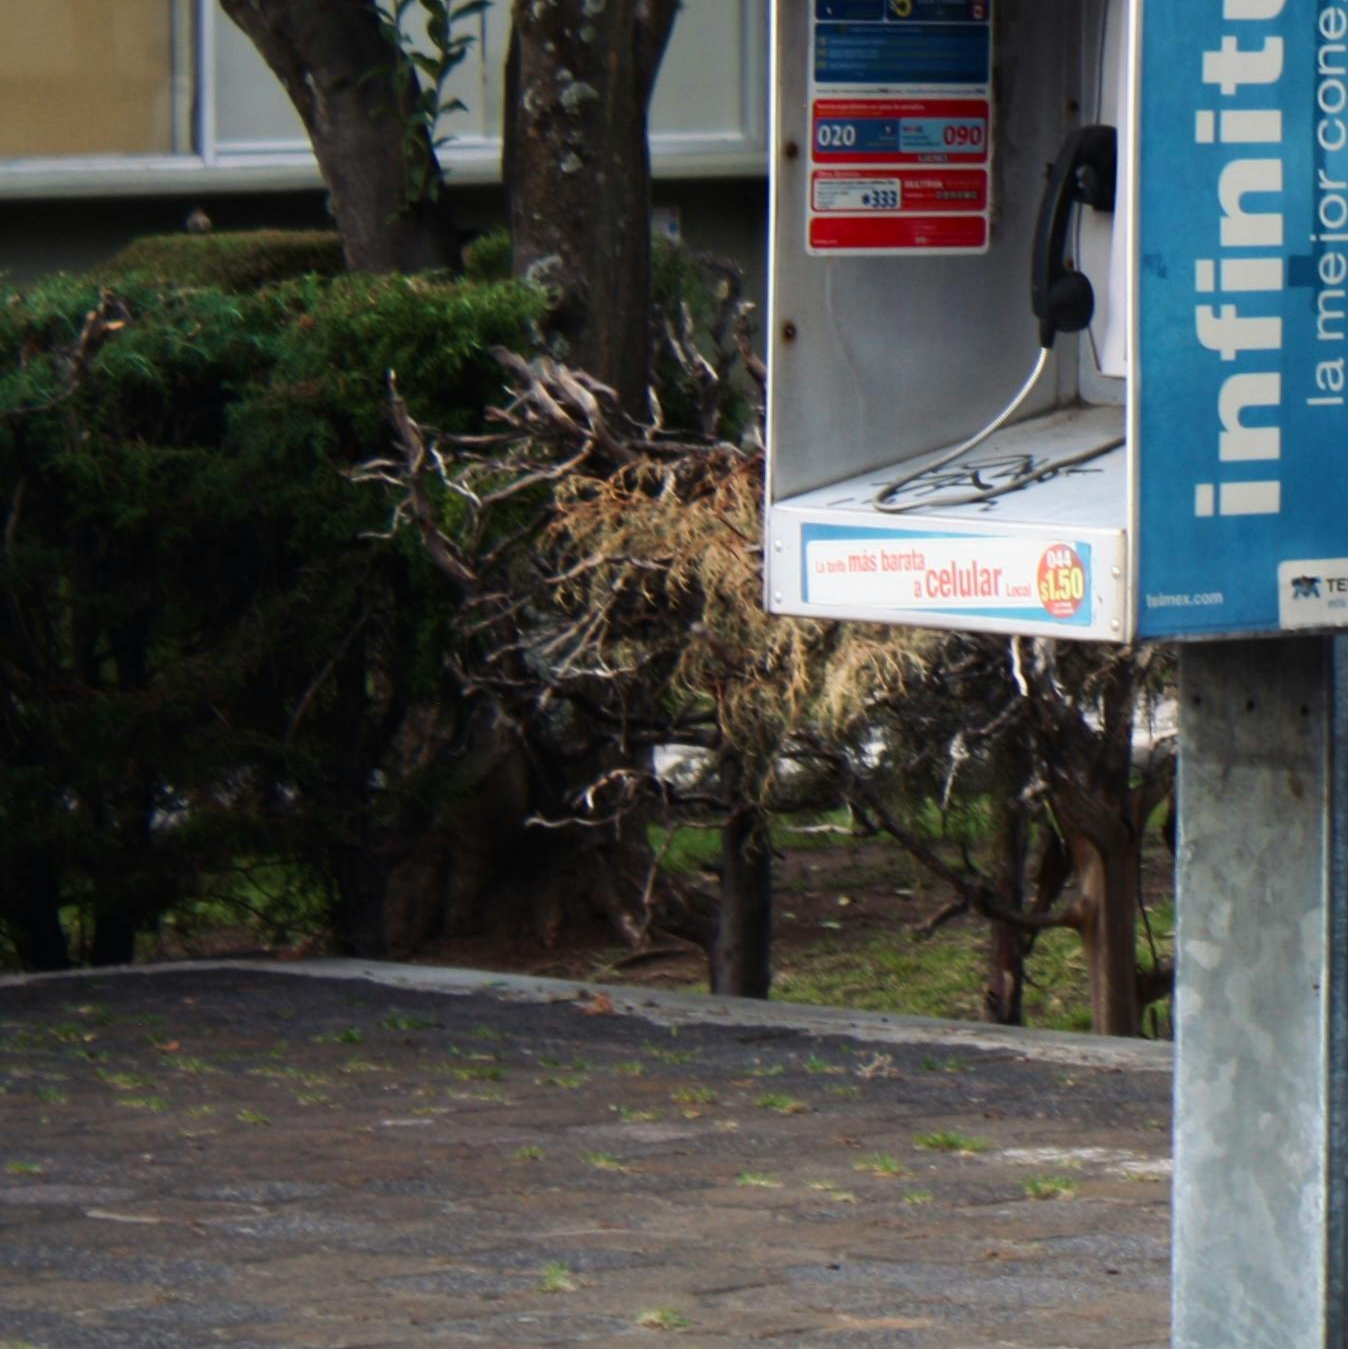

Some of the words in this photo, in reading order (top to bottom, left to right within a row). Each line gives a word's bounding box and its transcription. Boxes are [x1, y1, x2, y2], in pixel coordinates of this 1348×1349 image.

[817, 125, 856, 147] 020
[943, 125, 982, 146] 090
[1307, 359, 1345, 406] la
[848, 549, 878, 573] más
[880, 549, 925, 572] barata
[913, 579, 922, 598] a
[926, 560, 1002, 599] celular
[1040, 568, 1084, 602] $1.50
[1146, 591, 1224, 609] telmex.com
